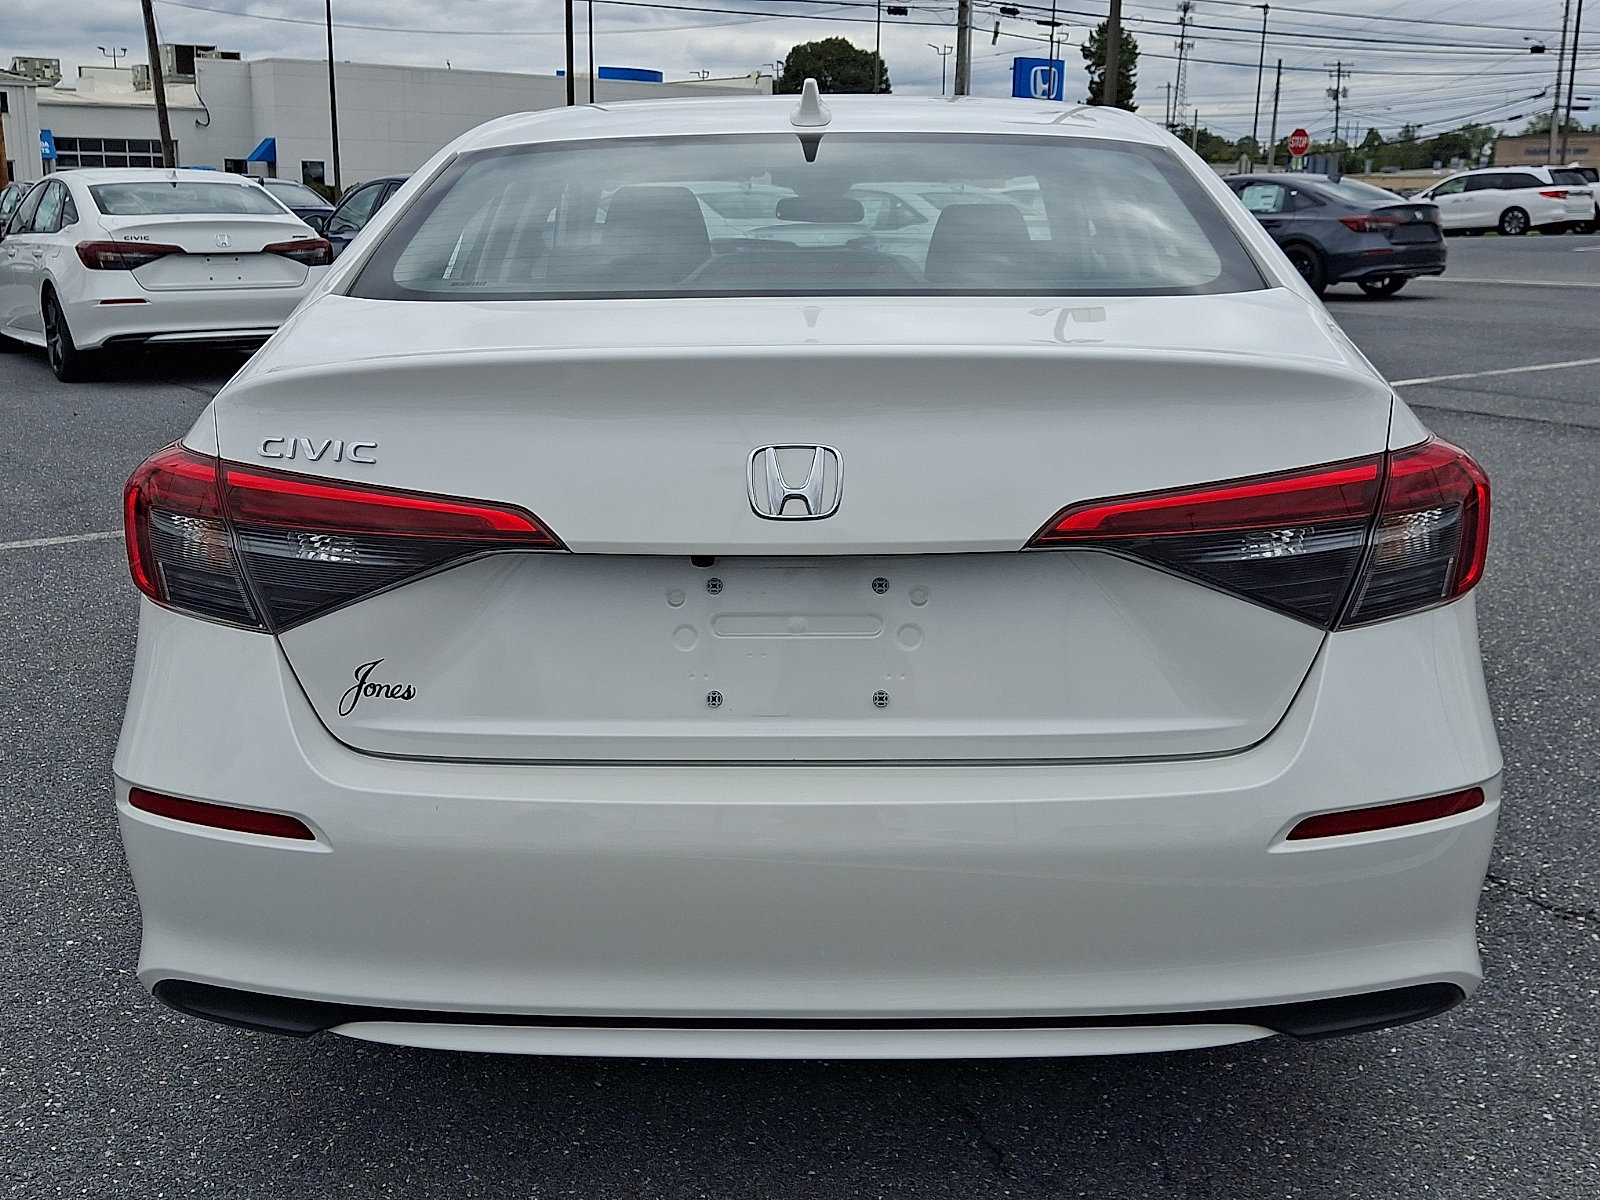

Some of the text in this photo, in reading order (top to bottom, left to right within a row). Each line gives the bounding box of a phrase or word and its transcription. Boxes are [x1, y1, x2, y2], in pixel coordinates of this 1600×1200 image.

[1290, 136, 1308, 148] STOP
[256, 437, 378, 464] CIVIC
[338, 658, 417, 717] Jones
